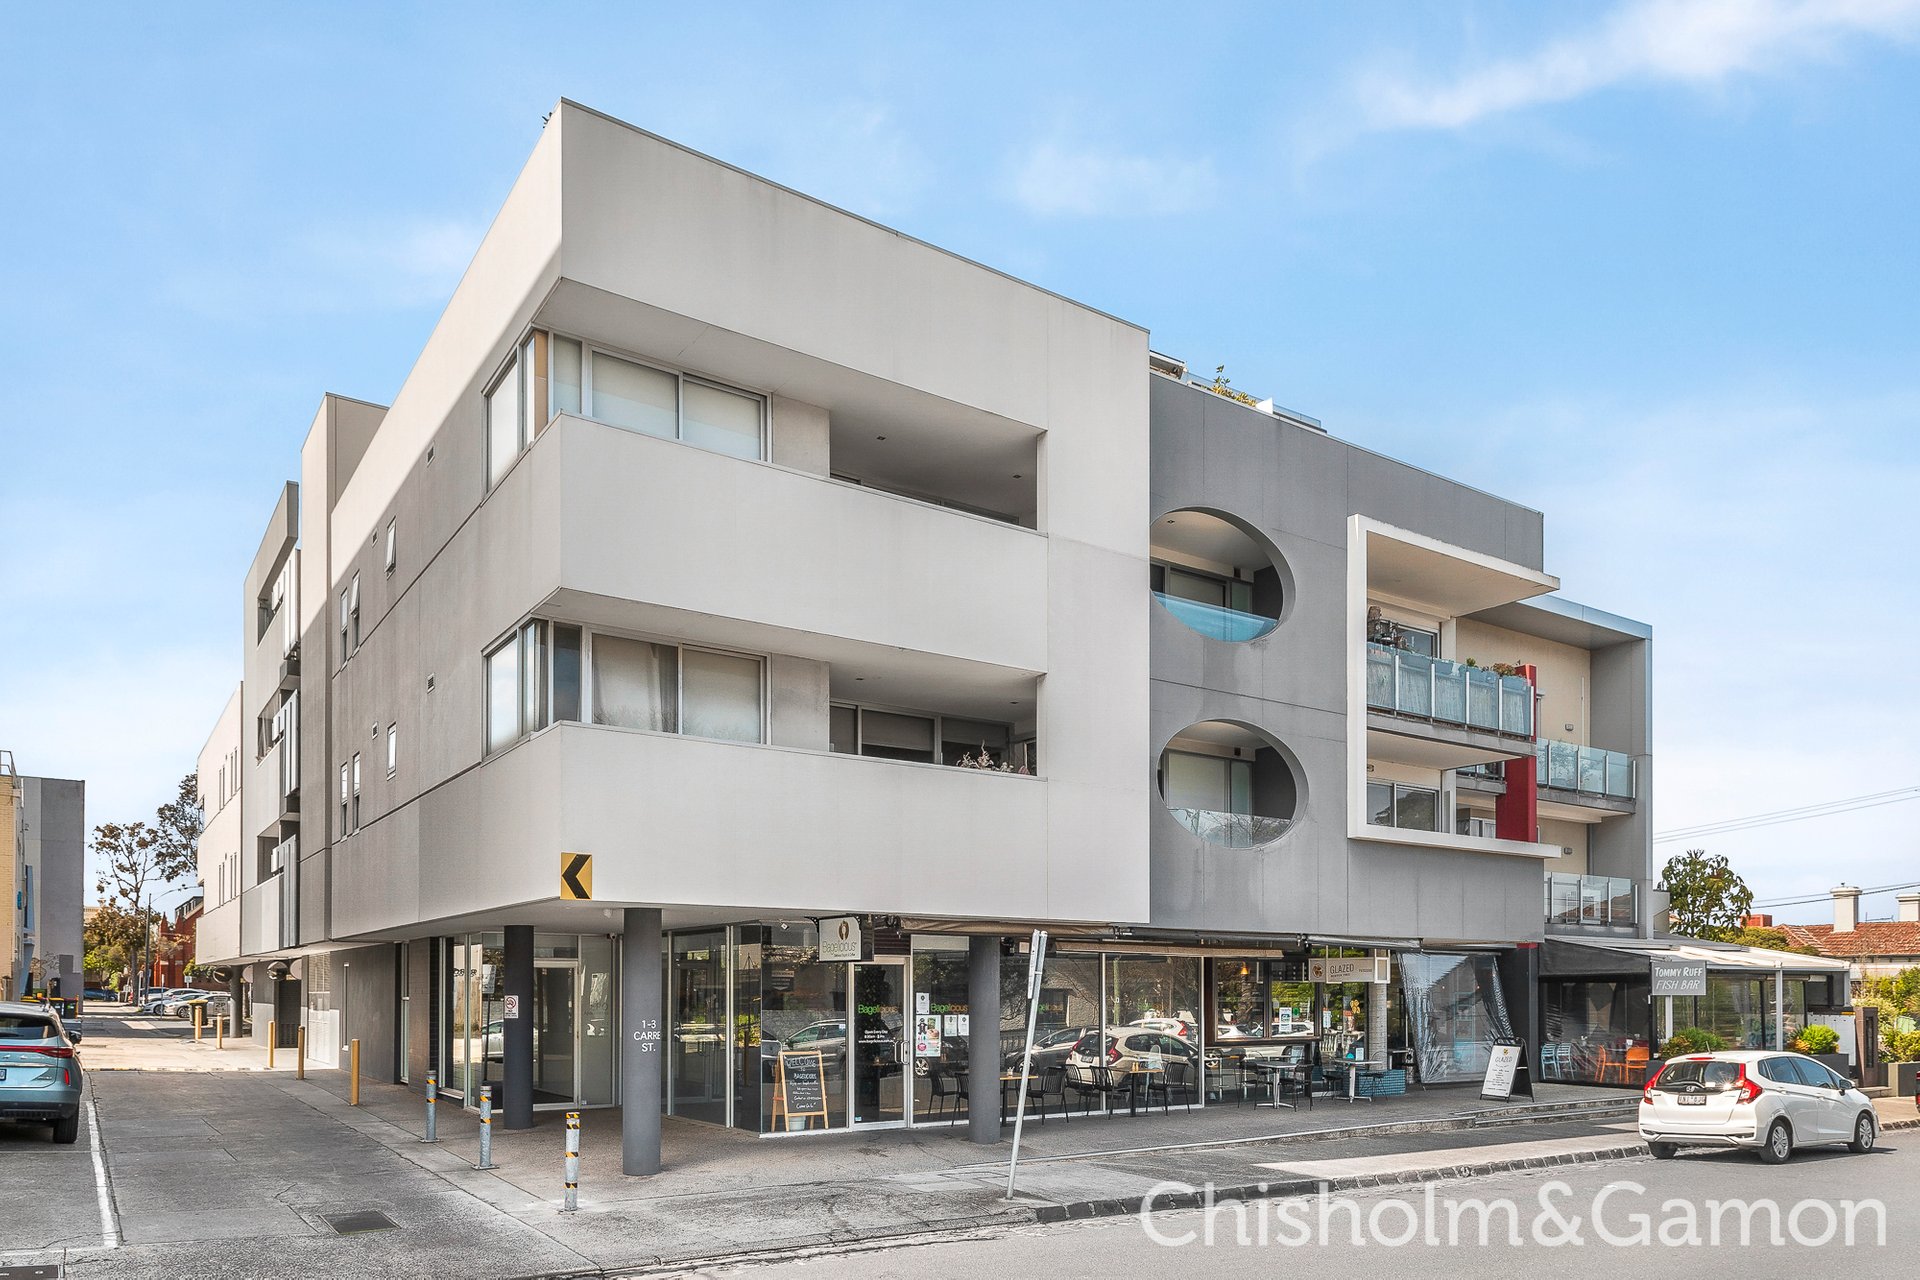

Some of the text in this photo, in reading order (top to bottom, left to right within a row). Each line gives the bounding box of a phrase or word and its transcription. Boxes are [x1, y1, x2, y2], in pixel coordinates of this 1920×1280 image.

[1329, 963, 1355, 975] GLAZED
[1654, 966, 1703, 978] TOMMY RUFF
[1655, 980, 1700, 990] FISH BAR
[858, 1004, 899, 1015] Bagelicious
[931, 1003, 969, 1014] Bagelicious
[641, 1019, 657, 1029] 1-3
[633, 1031, 661, 1041] CARRE
[641, 1042, 656, 1052] ST.
